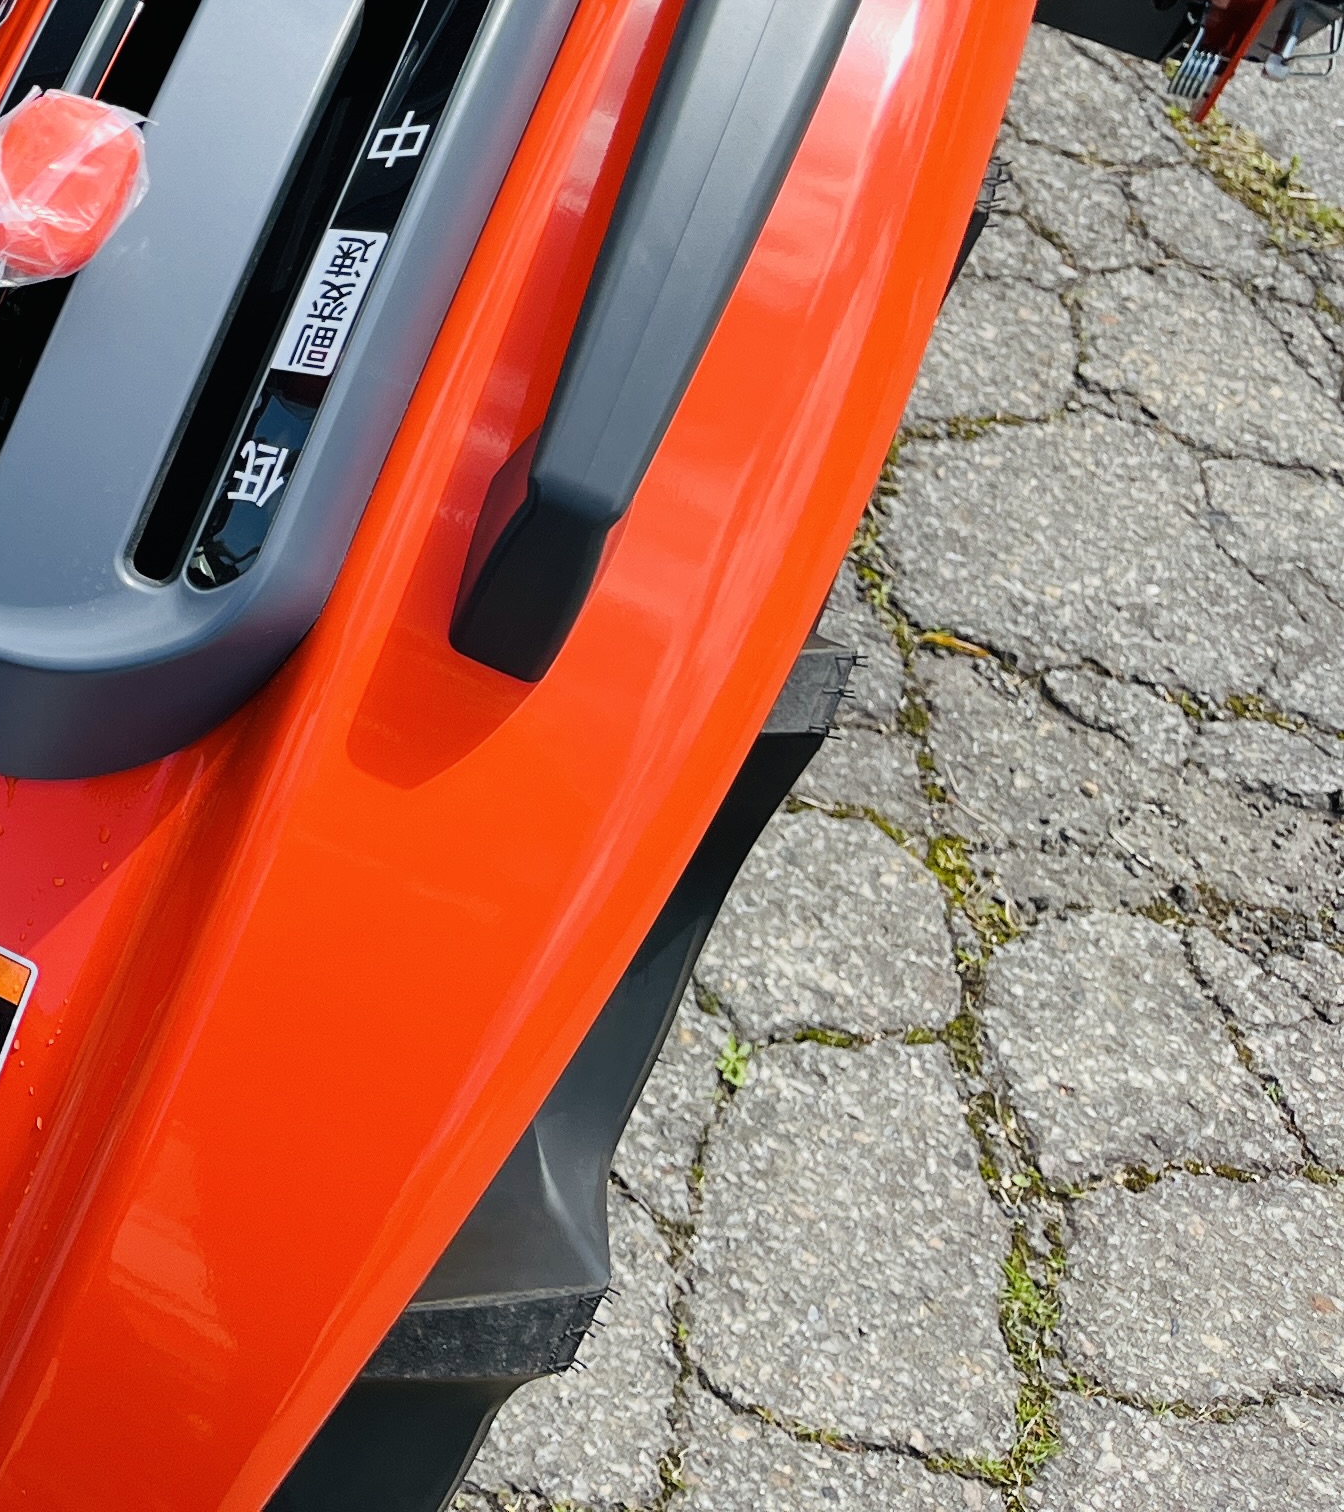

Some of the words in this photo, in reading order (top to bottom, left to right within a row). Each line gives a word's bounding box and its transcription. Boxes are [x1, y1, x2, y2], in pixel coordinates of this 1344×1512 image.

[367, 111, 430, 168] 中
[288, 237, 377, 371] 副変速
[227, 440, 290, 508] 低
